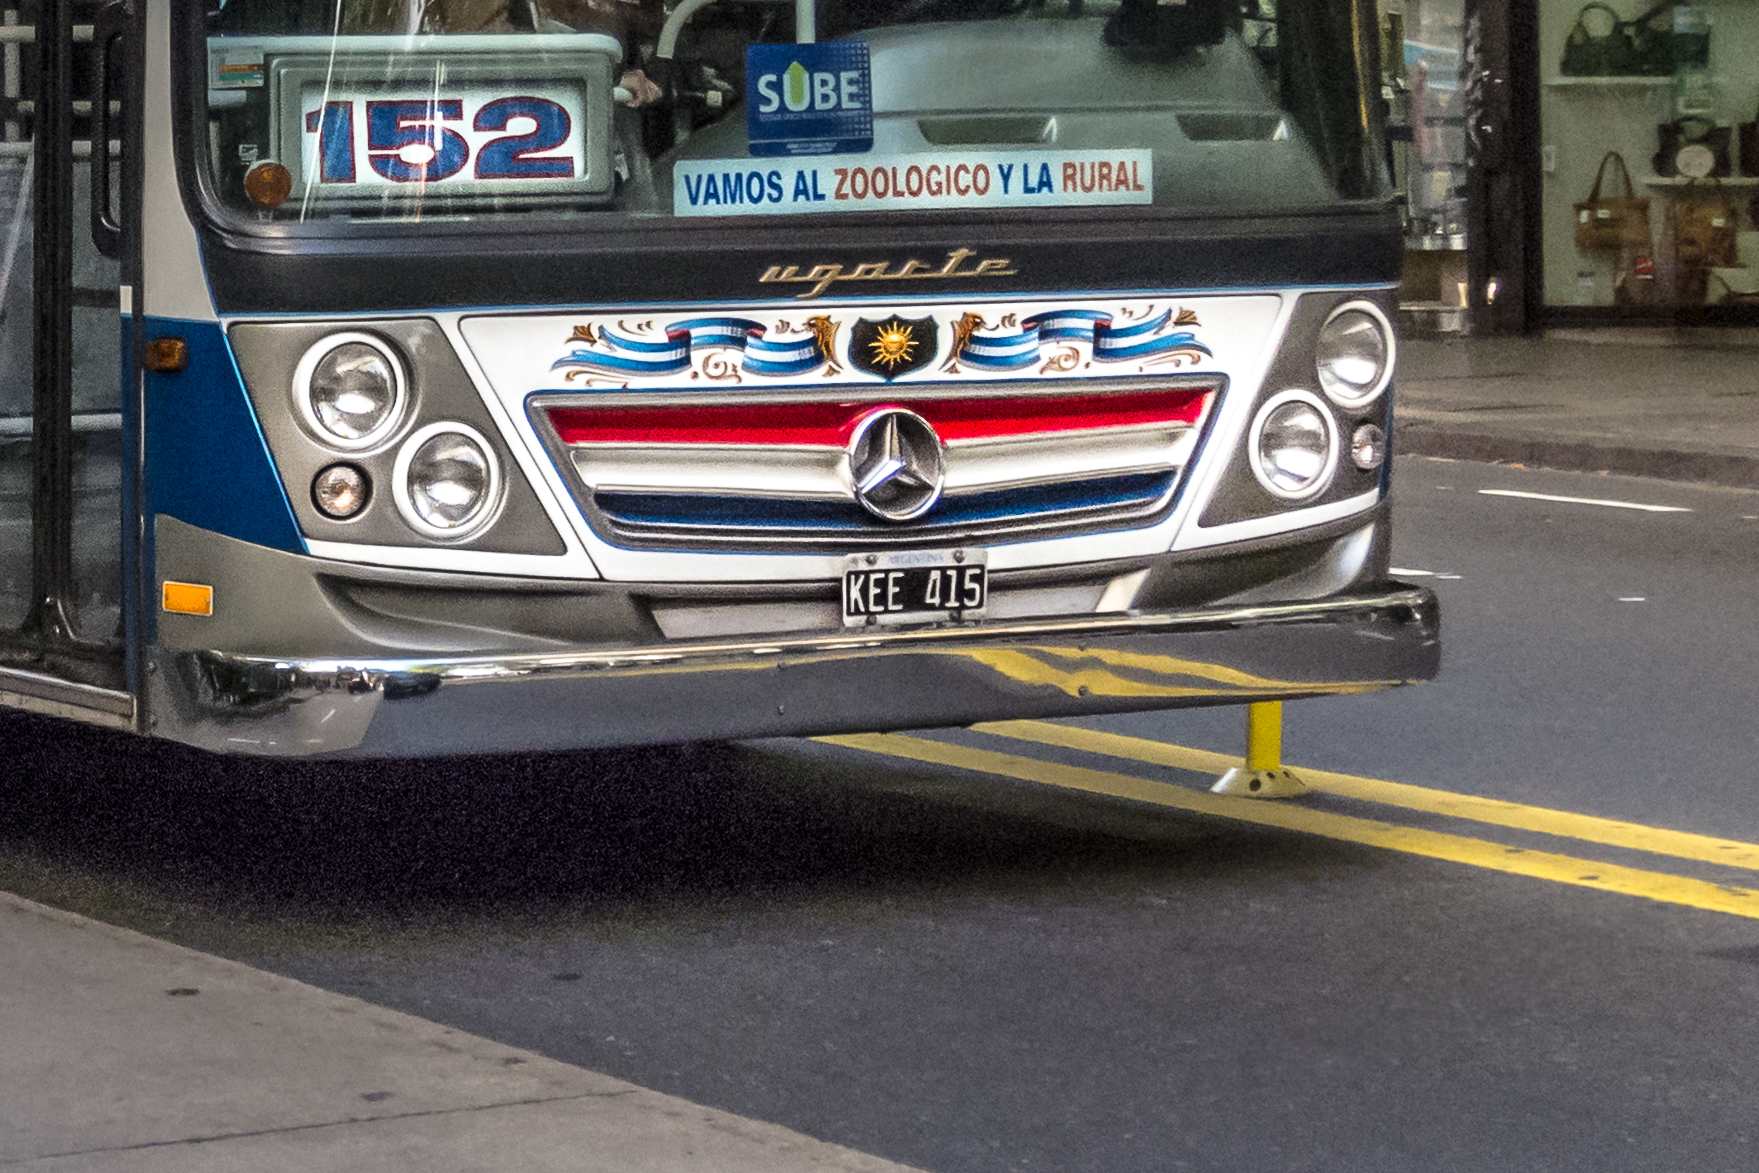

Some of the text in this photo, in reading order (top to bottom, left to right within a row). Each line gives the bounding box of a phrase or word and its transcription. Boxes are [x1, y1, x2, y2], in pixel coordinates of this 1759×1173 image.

[757, 63, 864, 114] SUBE
[305, 96, 576, 184] 152
[684, 161, 1144, 206] VAMOS AL ZOOLOGICO Y LA RURAL
[759, 247, 1019, 301] ugarte
[849, 568, 982, 614] KEE 415
